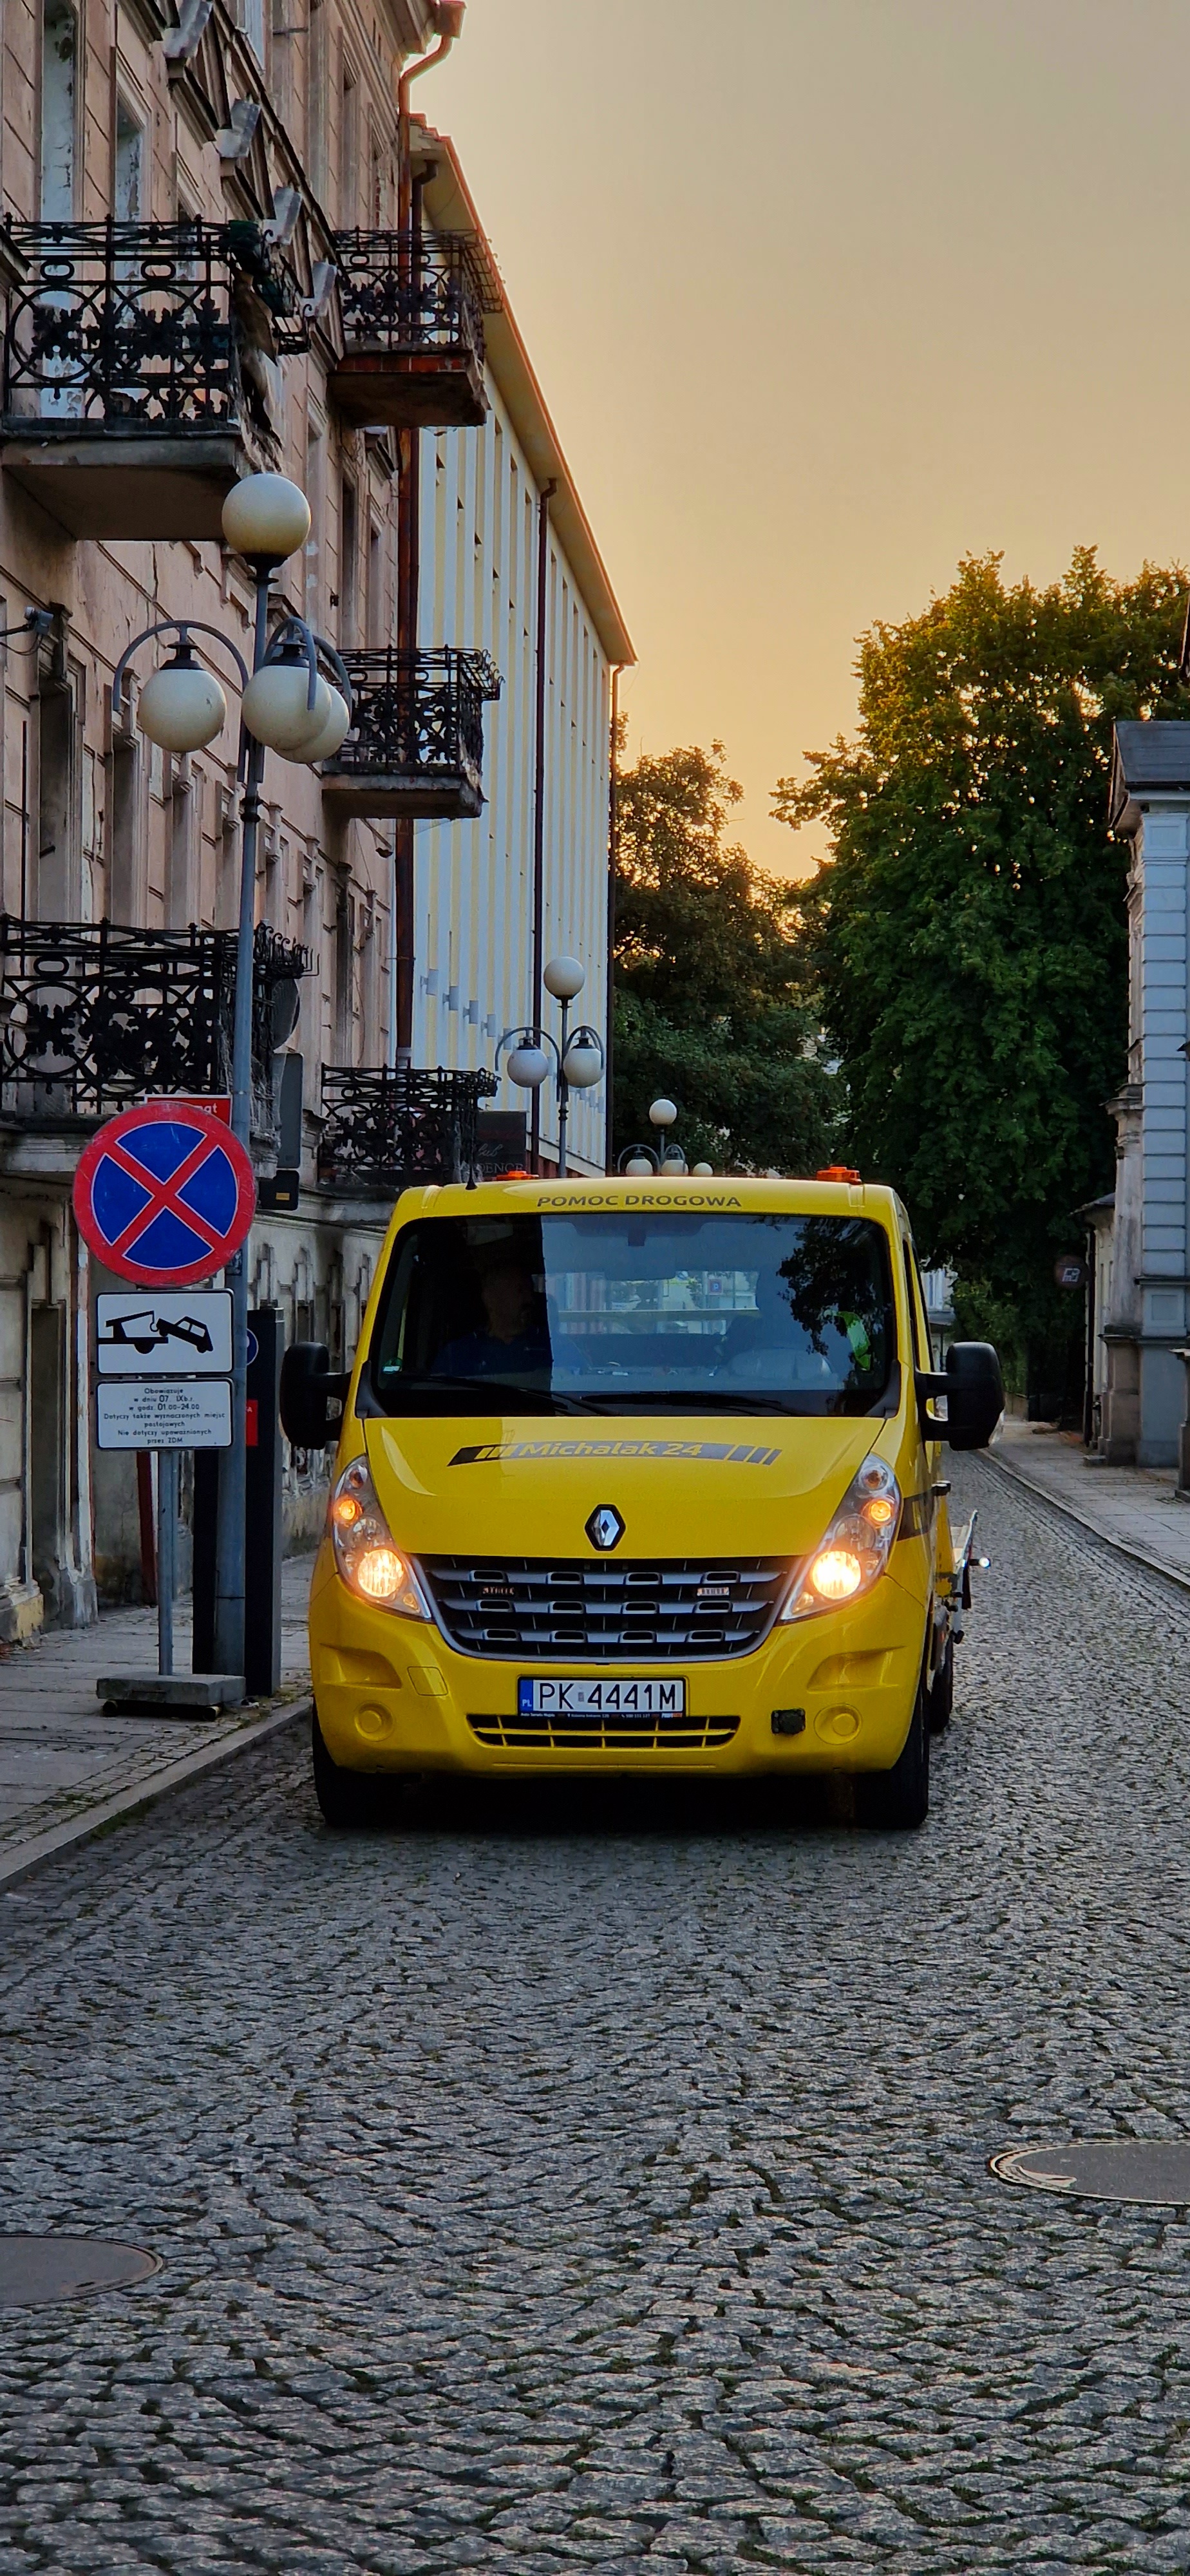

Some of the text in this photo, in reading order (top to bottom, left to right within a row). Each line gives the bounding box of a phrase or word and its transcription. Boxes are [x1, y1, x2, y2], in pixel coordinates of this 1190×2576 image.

[537, 1195, 742, 1207] POMOC DROGOWA
[154, 1412, 200, 1420] wyznaczonych
[519, 1442, 704, 1457] Michalak 24
[539, 1682, 676, 1710] PK 4441M
[522, 1699, 533, 1707] PL
